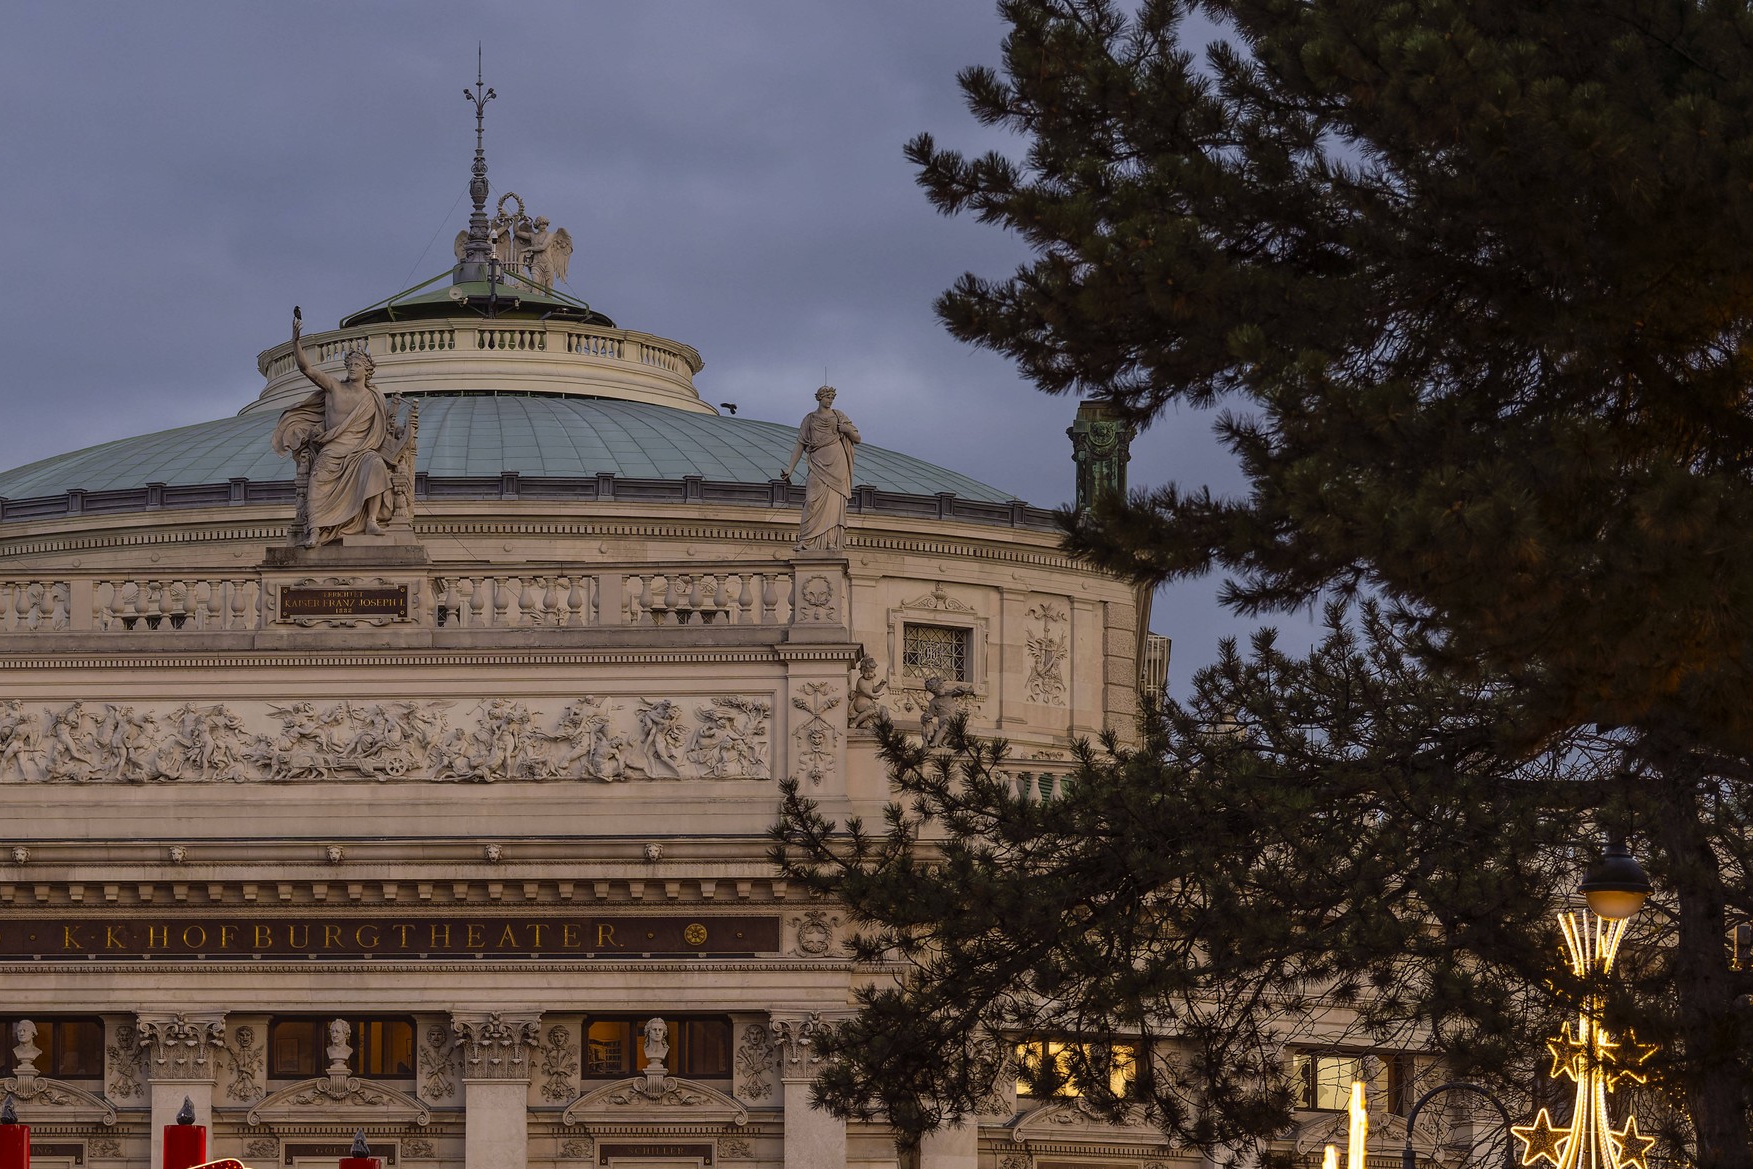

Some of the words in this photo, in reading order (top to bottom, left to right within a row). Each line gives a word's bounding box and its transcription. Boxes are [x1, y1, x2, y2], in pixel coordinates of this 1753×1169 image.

[284, 598, 320, 608] KAISER
[323, 598, 355, 608] FRANZ
[358, 598, 396, 607] JOSEPH
